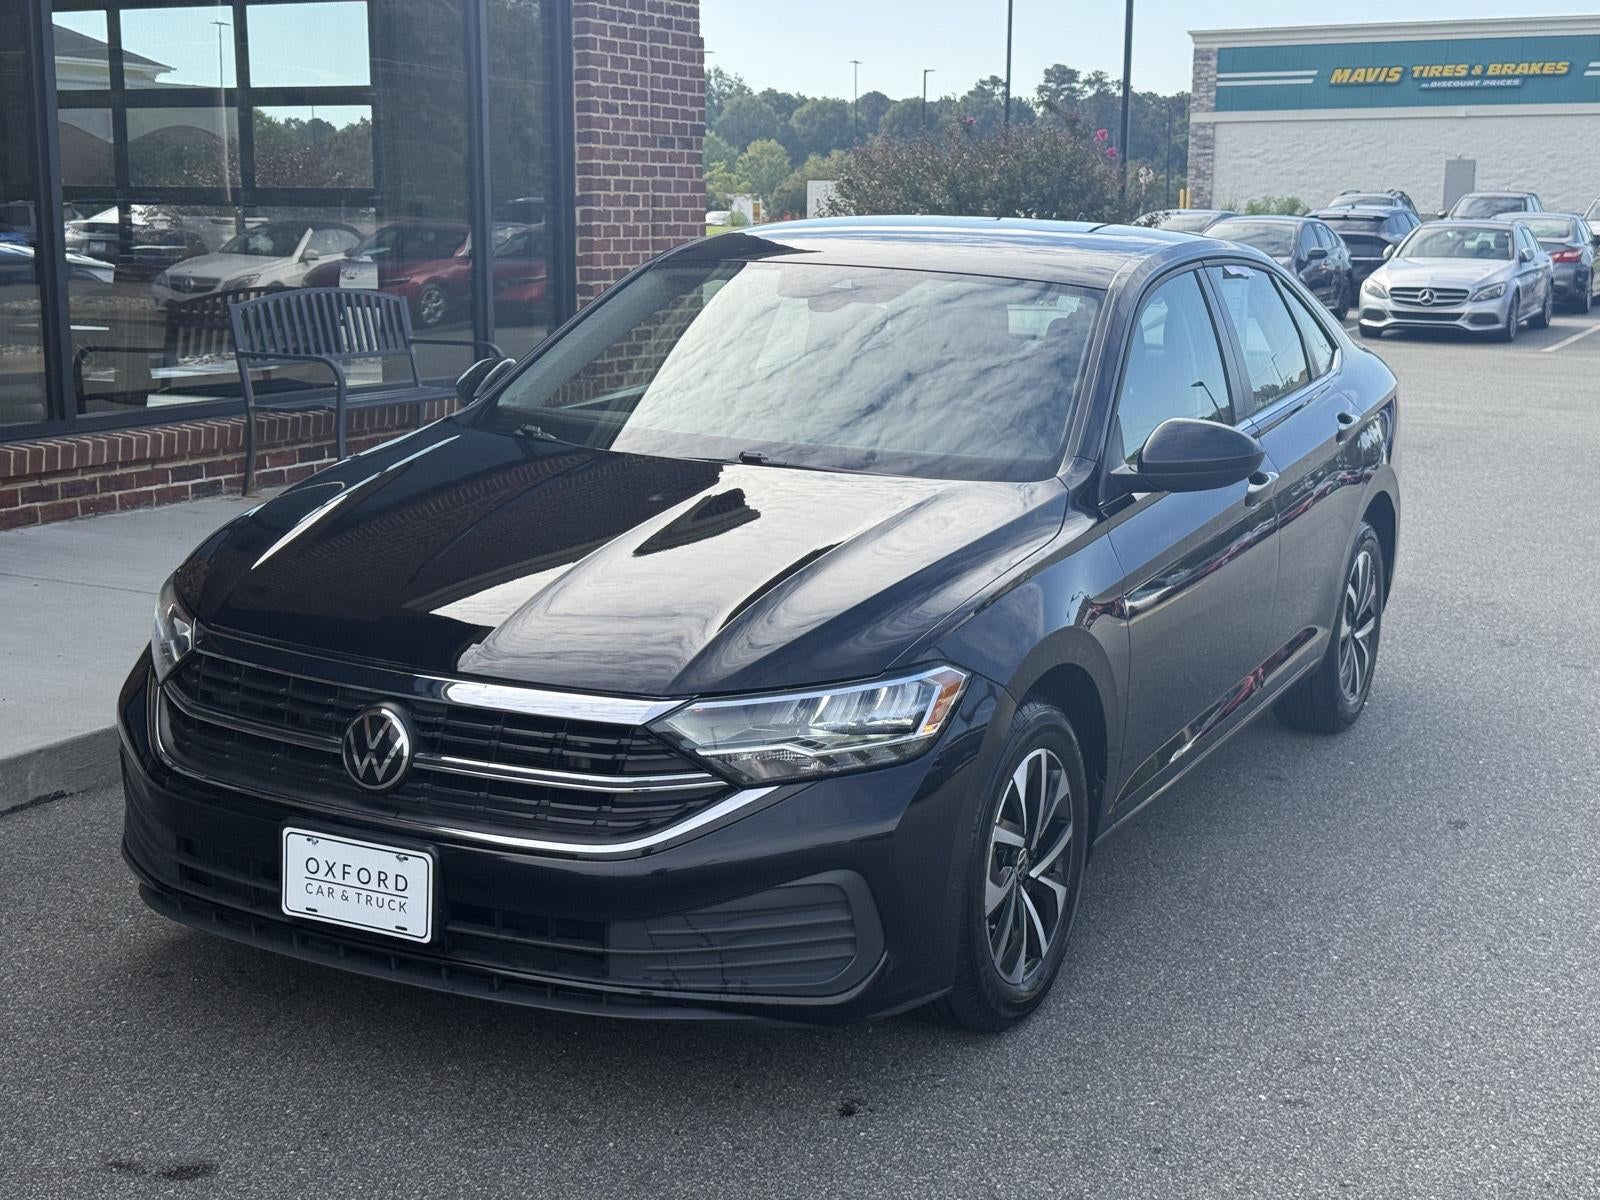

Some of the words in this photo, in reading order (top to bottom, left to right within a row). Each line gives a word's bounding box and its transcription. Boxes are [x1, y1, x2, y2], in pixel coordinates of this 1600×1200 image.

[1329, 66, 1404, 84] MAVIS
[1411, 64, 1469, 78] TIRES
[1471, 64, 1483, 76] &
[1486, 60, 1570, 76] BRAKES
[1429, 79, 1480, 88] DISCOUNT
[1482, 78, 1520, 87] PRICES
[305, 857, 408, 892] OXFORD
[305, 882, 335, 900] CAR
[340, 889, 350, 902] &
[354, 892, 407, 914] TRUCK
